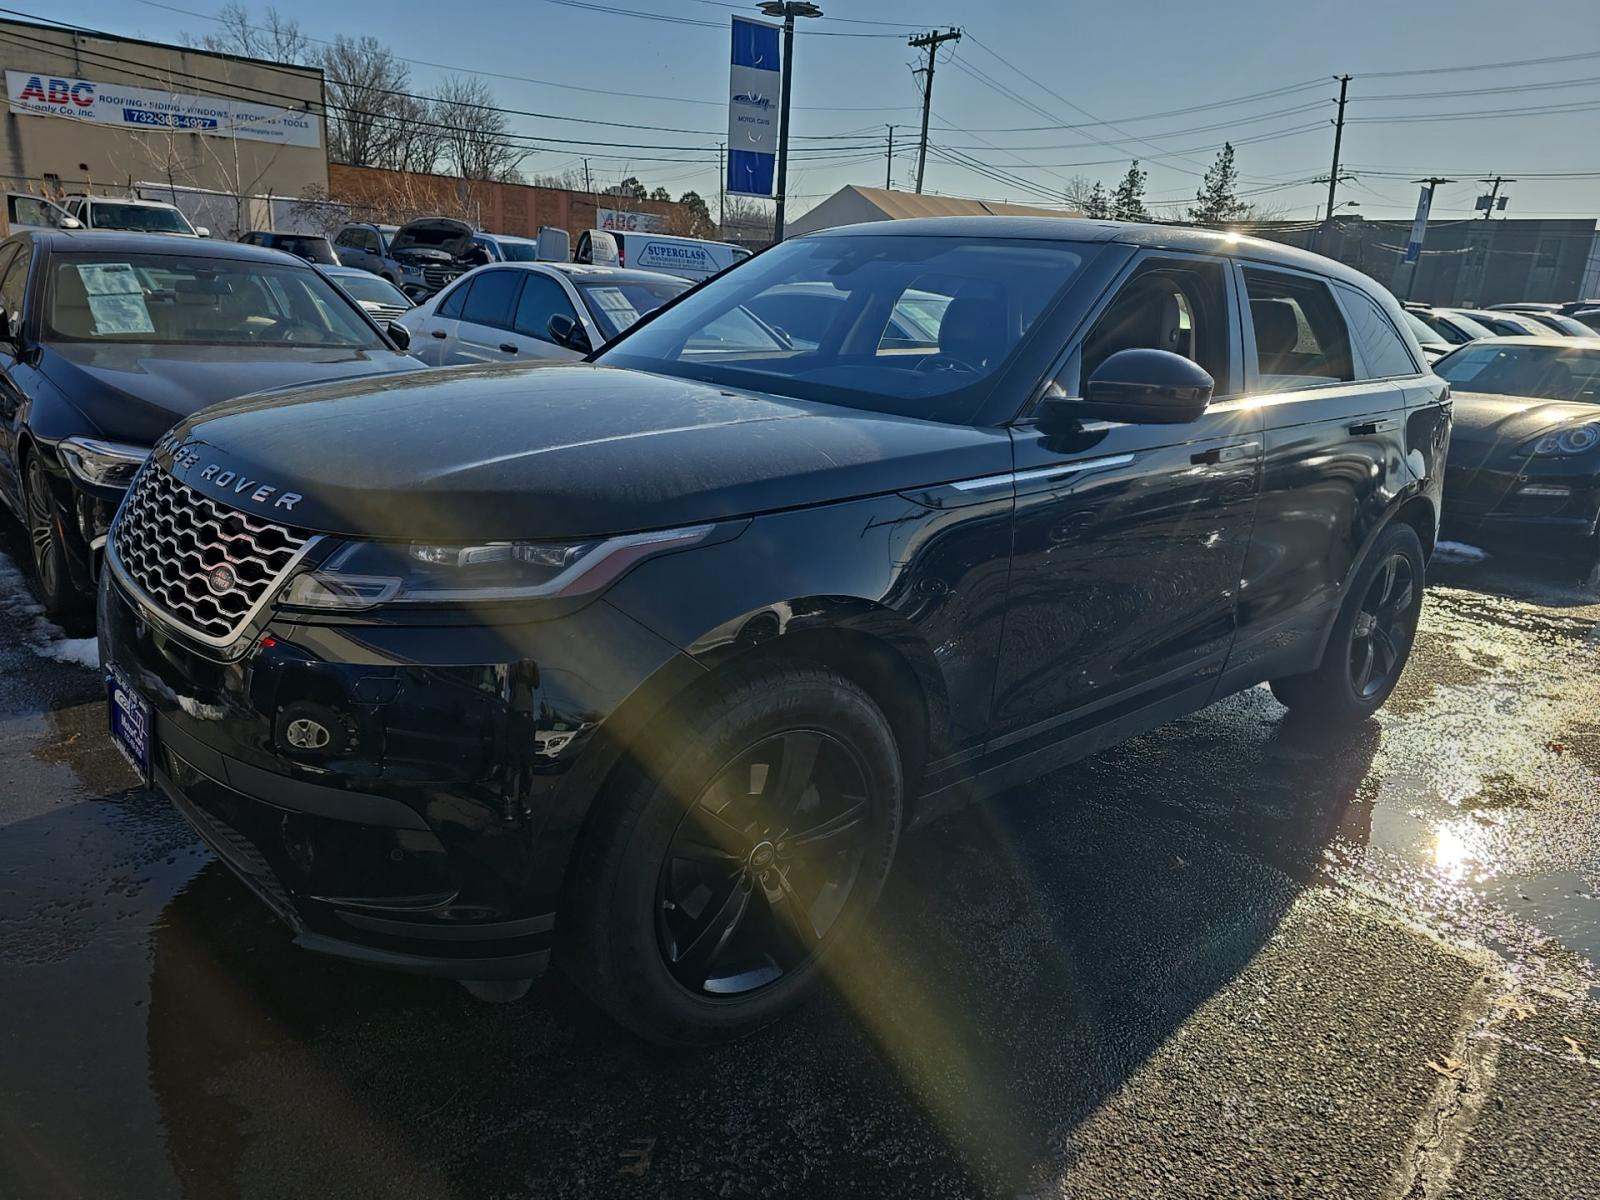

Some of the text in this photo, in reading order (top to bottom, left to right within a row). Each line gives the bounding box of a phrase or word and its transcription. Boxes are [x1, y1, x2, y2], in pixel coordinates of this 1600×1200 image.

[20, 76, 97, 107] ABC
[59, 106, 76, 116] Co.
[78, 108, 96, 118] Inc.
[98, 94, 142, 108] ROOFING
[186, 105, 229, 119] WINDOWS
[282, 118, 310, 129] TOOLS
[648, 245, 706, 260] SUPERGLASS
[200, 463, 303, 511] ROVER
